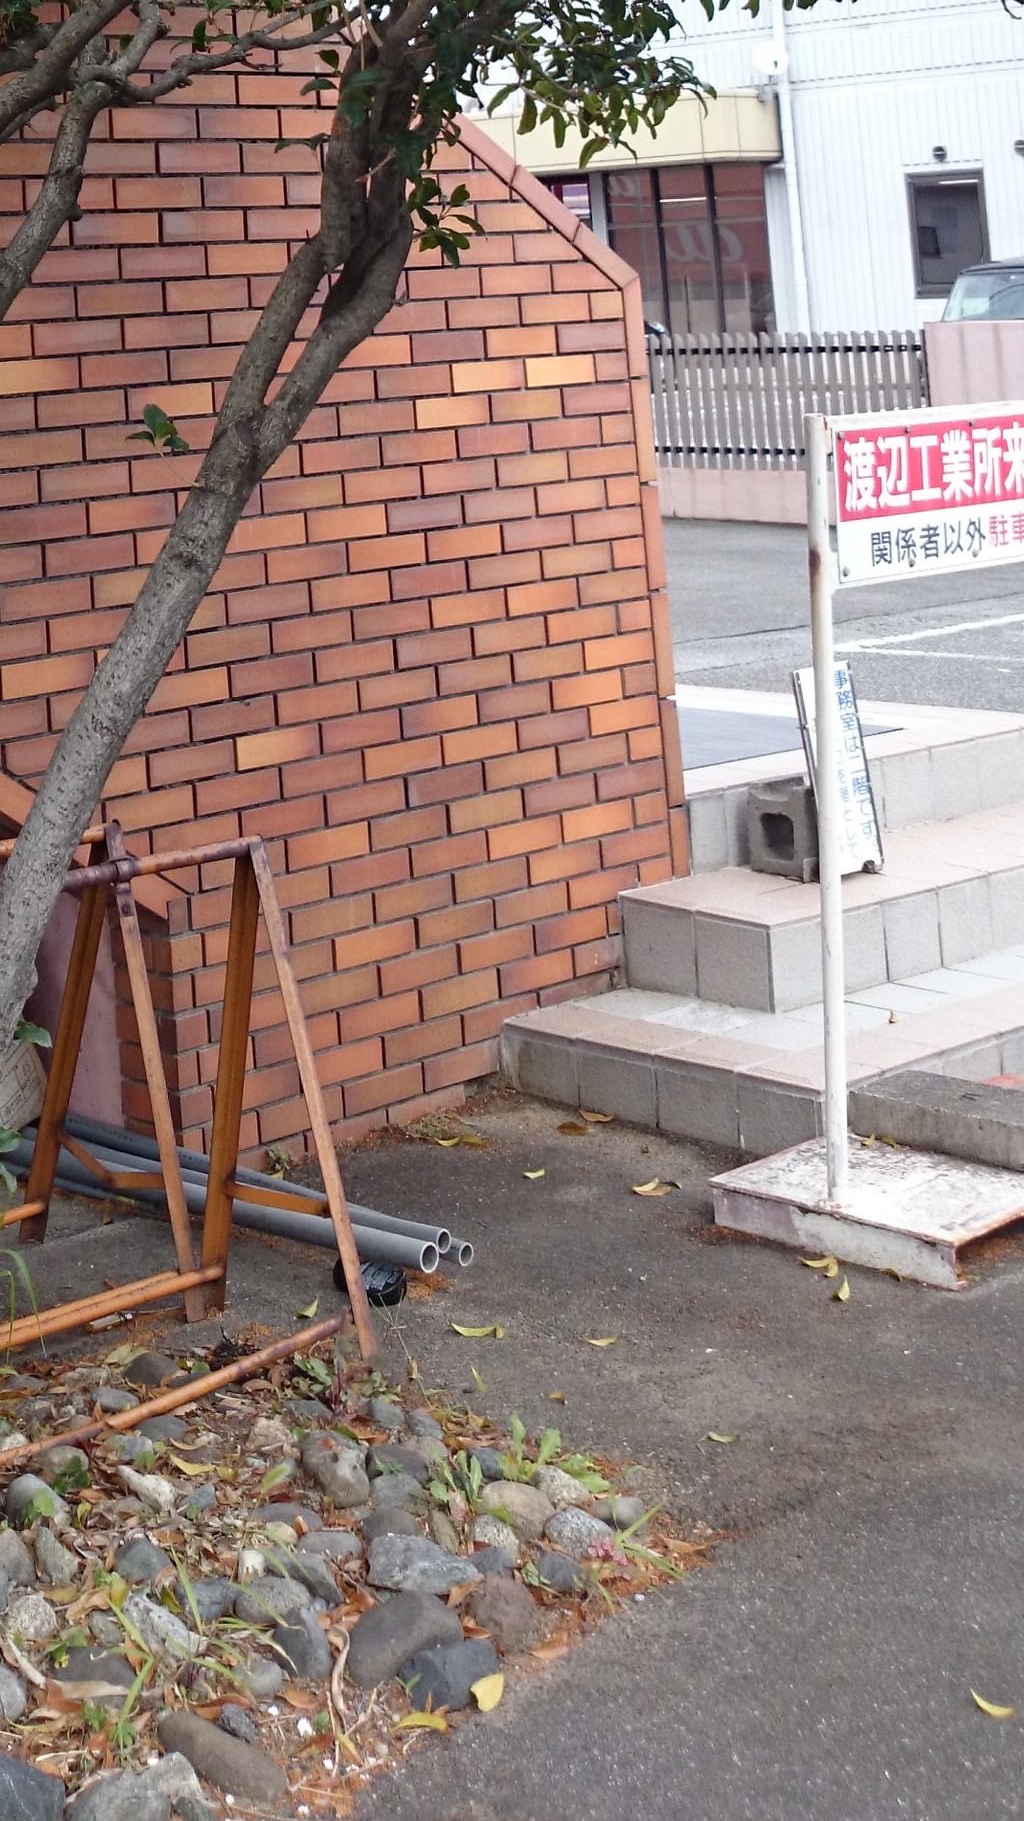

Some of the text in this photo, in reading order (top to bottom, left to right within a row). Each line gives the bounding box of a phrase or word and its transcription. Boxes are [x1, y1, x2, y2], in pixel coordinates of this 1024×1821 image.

[843, 422, 1024, 511] 渡辺工業所来
